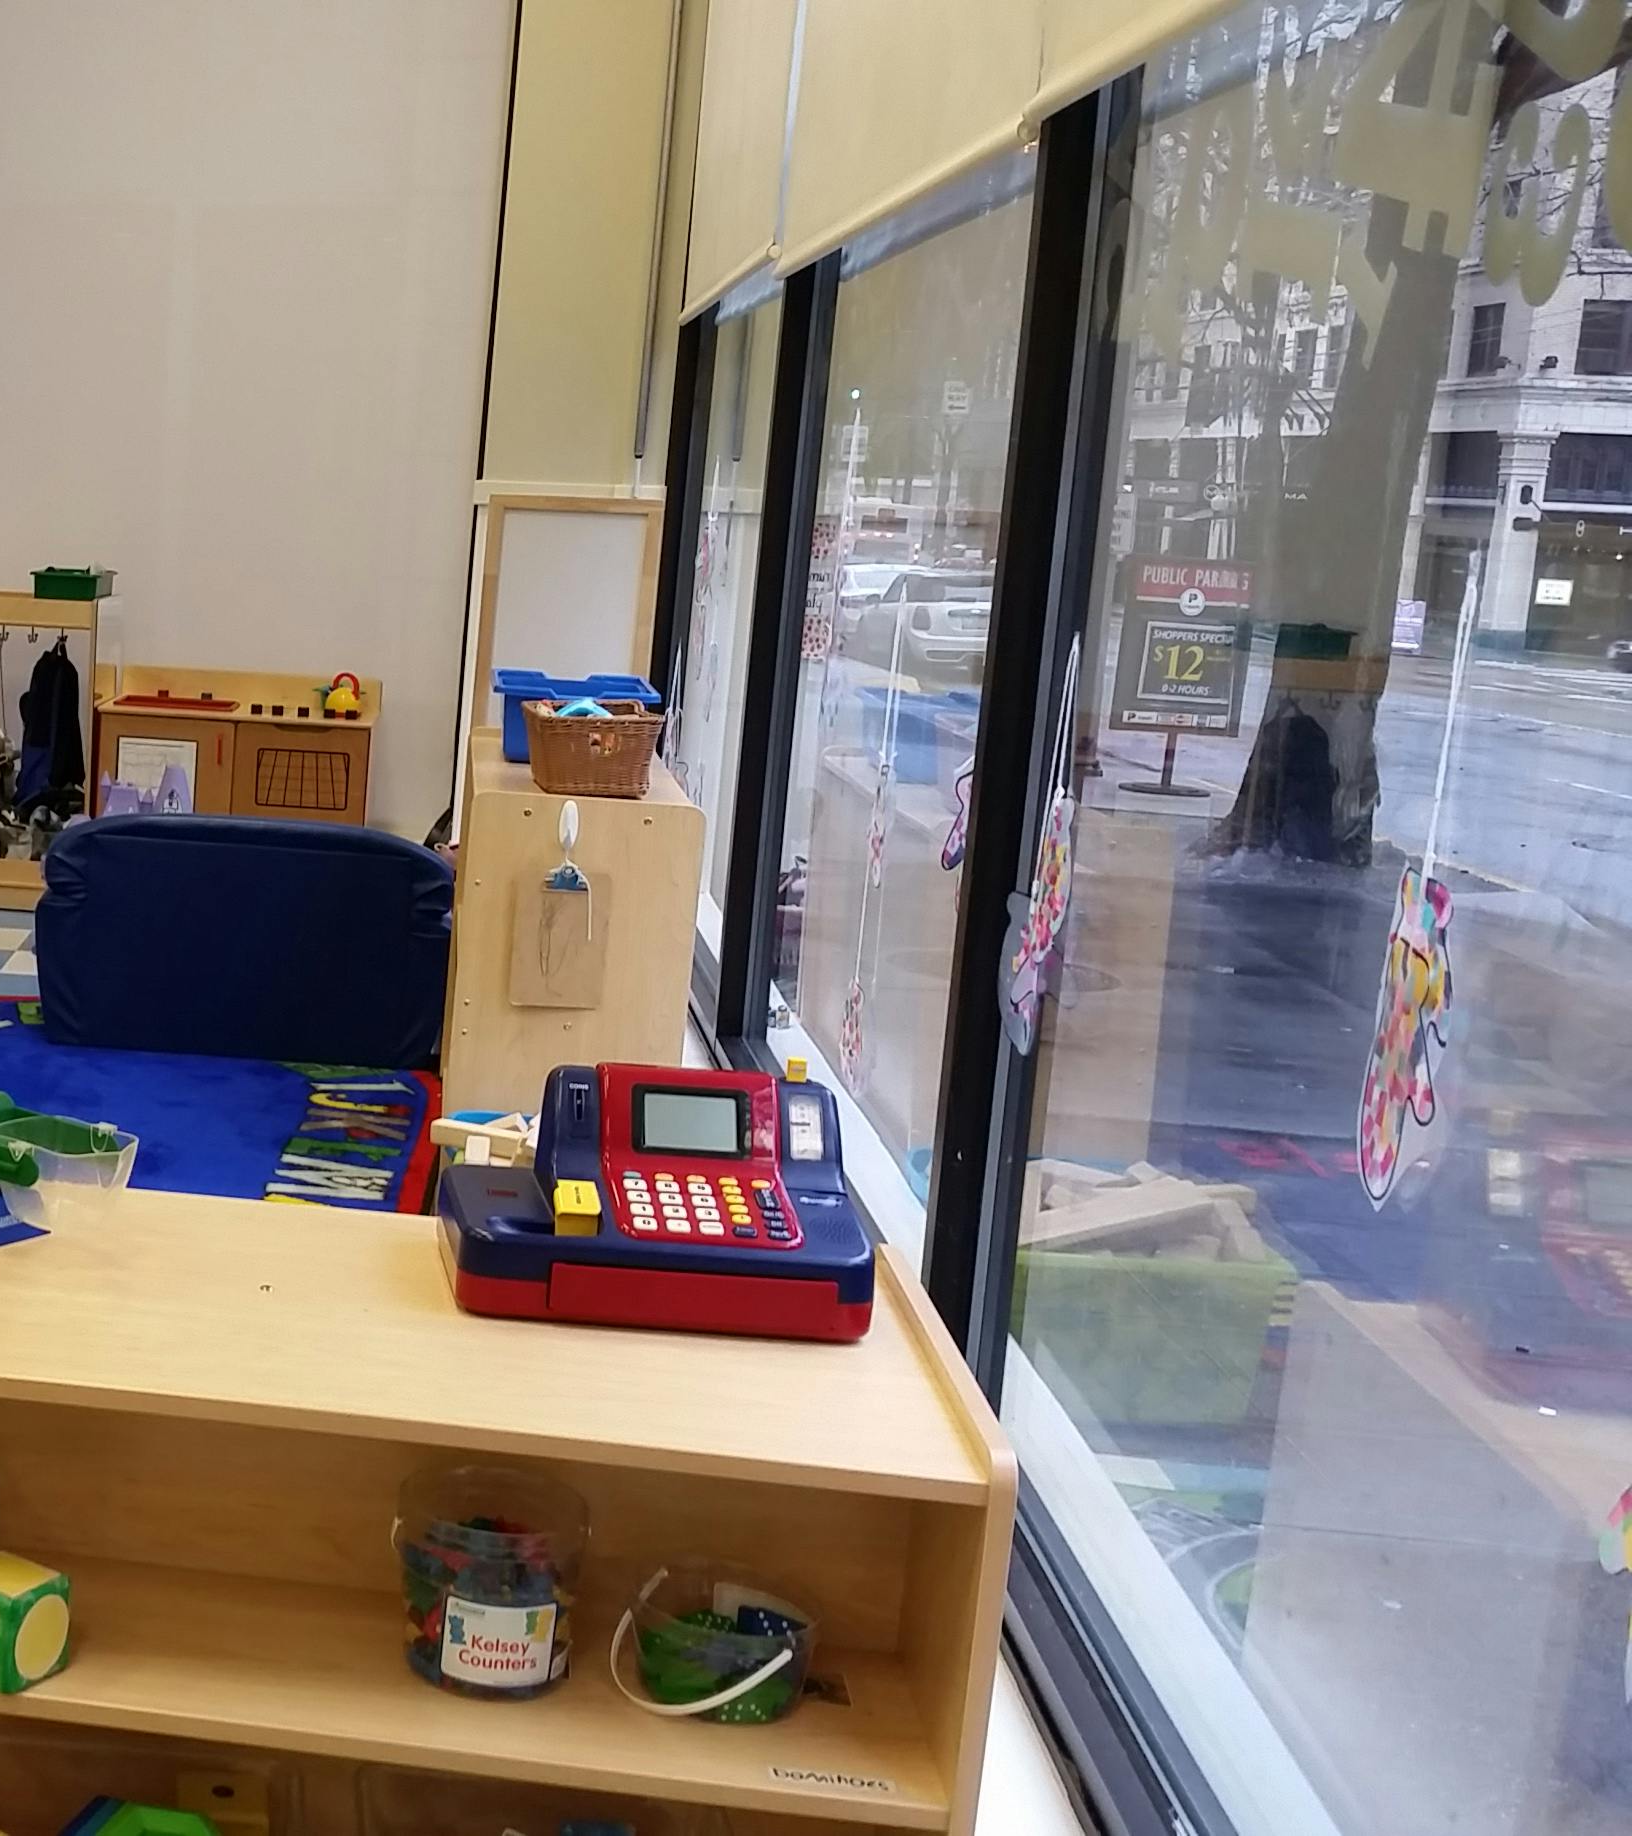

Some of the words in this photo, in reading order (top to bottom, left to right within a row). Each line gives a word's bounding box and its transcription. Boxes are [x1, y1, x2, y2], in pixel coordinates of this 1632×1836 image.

[1142, 565, 1188, 586] PUBLIC
[1152, 629, 1199, 641] SHOPPERS
[1177, 684, 1210, 696] HOURS
[471, 1634, 530, 1656] Kelsey
[458, 1649, 537, 1671] Counters
